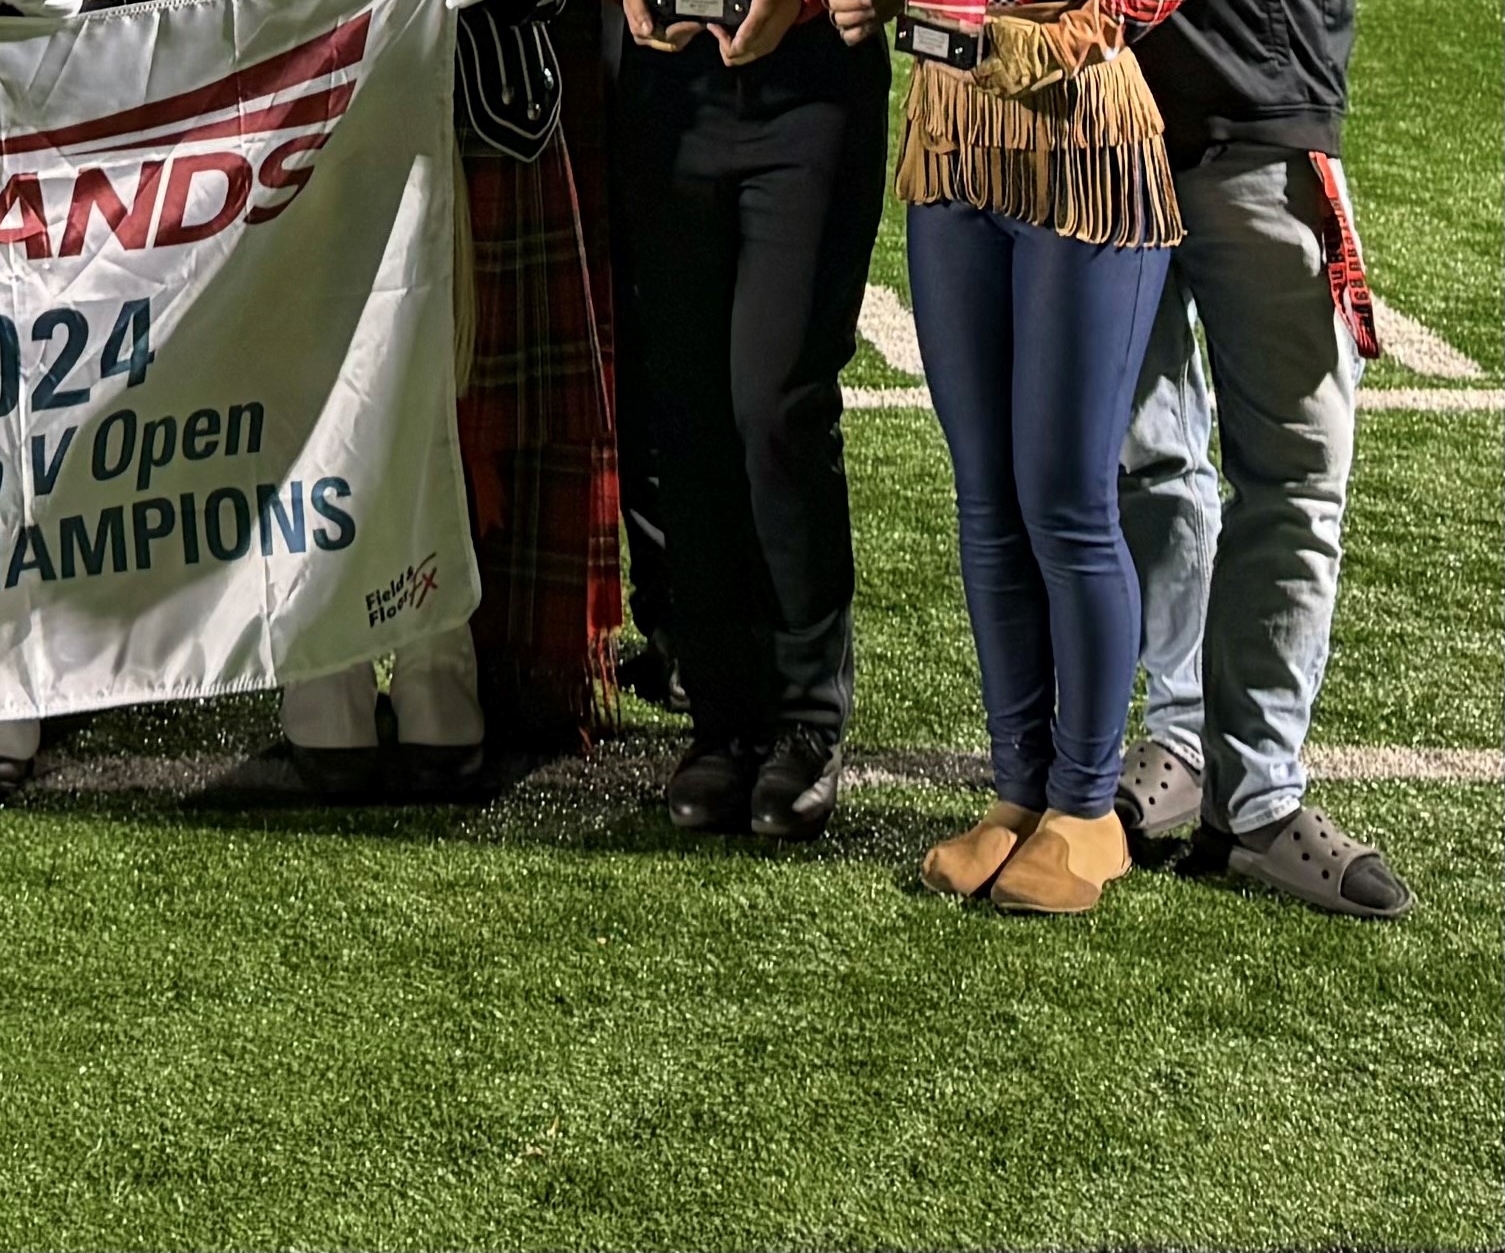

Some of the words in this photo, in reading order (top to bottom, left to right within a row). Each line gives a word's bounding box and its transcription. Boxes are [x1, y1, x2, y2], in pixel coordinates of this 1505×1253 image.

[32, 426, 72, 497] V
[91, 402, 264, 491] Open
[365, 572, 404, 612] Field
[368, 588, 409, 628] Floor
